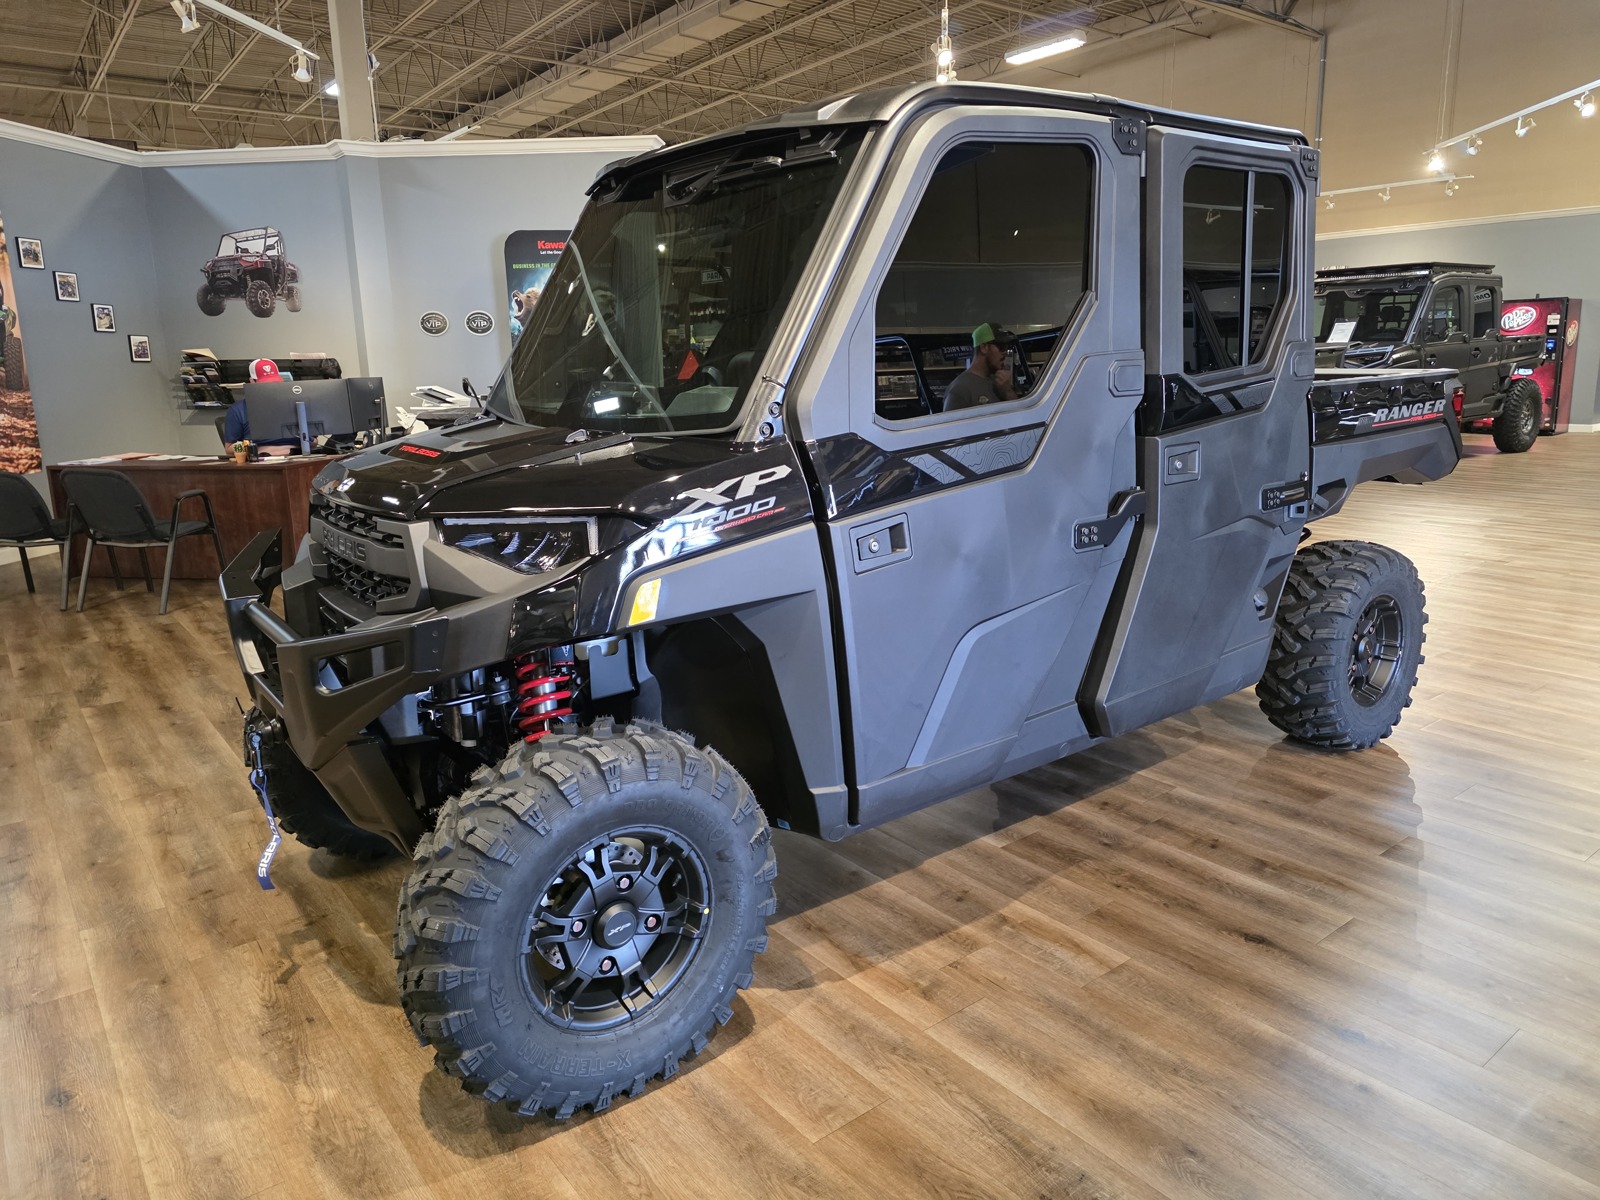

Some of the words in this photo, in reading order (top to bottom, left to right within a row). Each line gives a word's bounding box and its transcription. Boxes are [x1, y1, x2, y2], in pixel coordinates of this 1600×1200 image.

[537, 240, 567, 249] Kawa
[1503, 311, 1534, 329] Pepper
[1512, 309, 1525, 319] Dr
[1373, 399, 1446, 423] RANGER
[671, 464, 793, 518] XP
[692, 496, 777, 531] 1000
[322, 526, 367, 563] POLARIS
[258, 815, 280, 878] POLARIS
[607, 921, 632, 937] XP
[518, 1036, 633, 1077] X-TERRAIN
